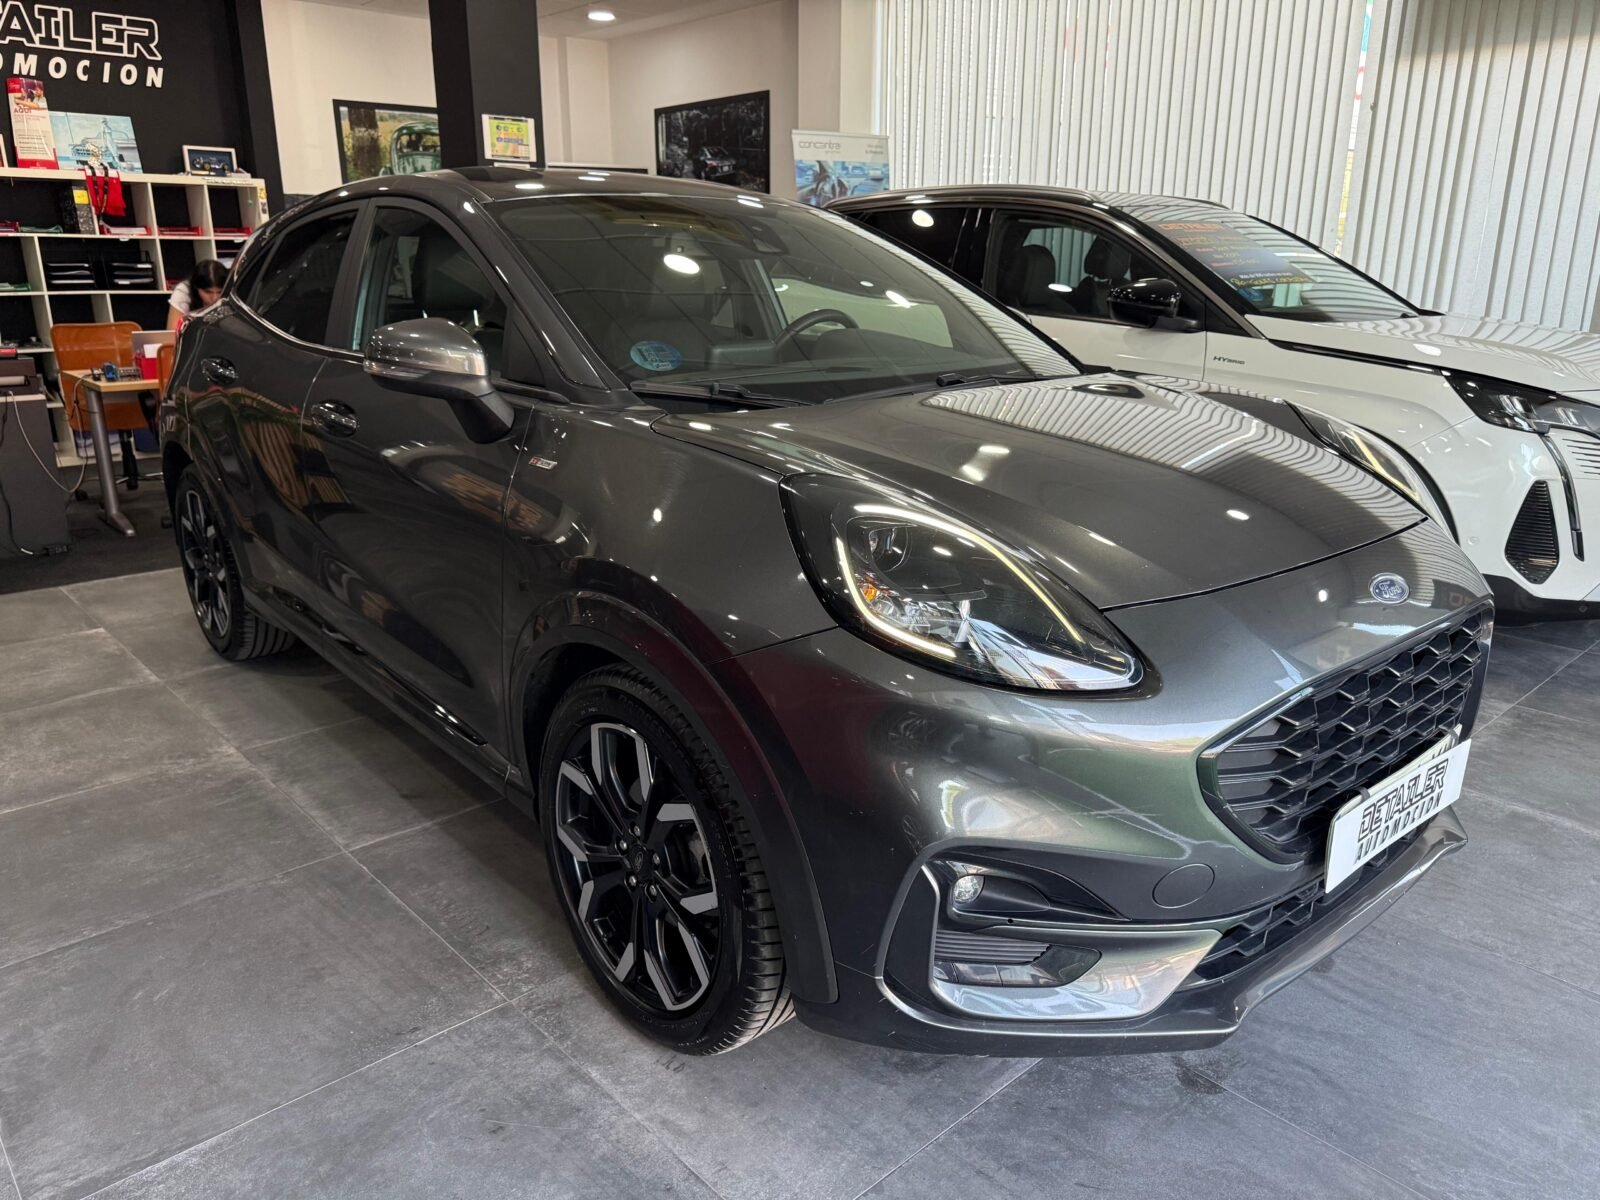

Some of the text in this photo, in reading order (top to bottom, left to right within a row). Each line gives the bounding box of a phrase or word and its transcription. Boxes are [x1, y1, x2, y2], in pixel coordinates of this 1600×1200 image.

[0, 1, 162, 60] AILER
[0, 53, 164, 88] MOCION
[1358, 758, 1449, 843] DETAILER
